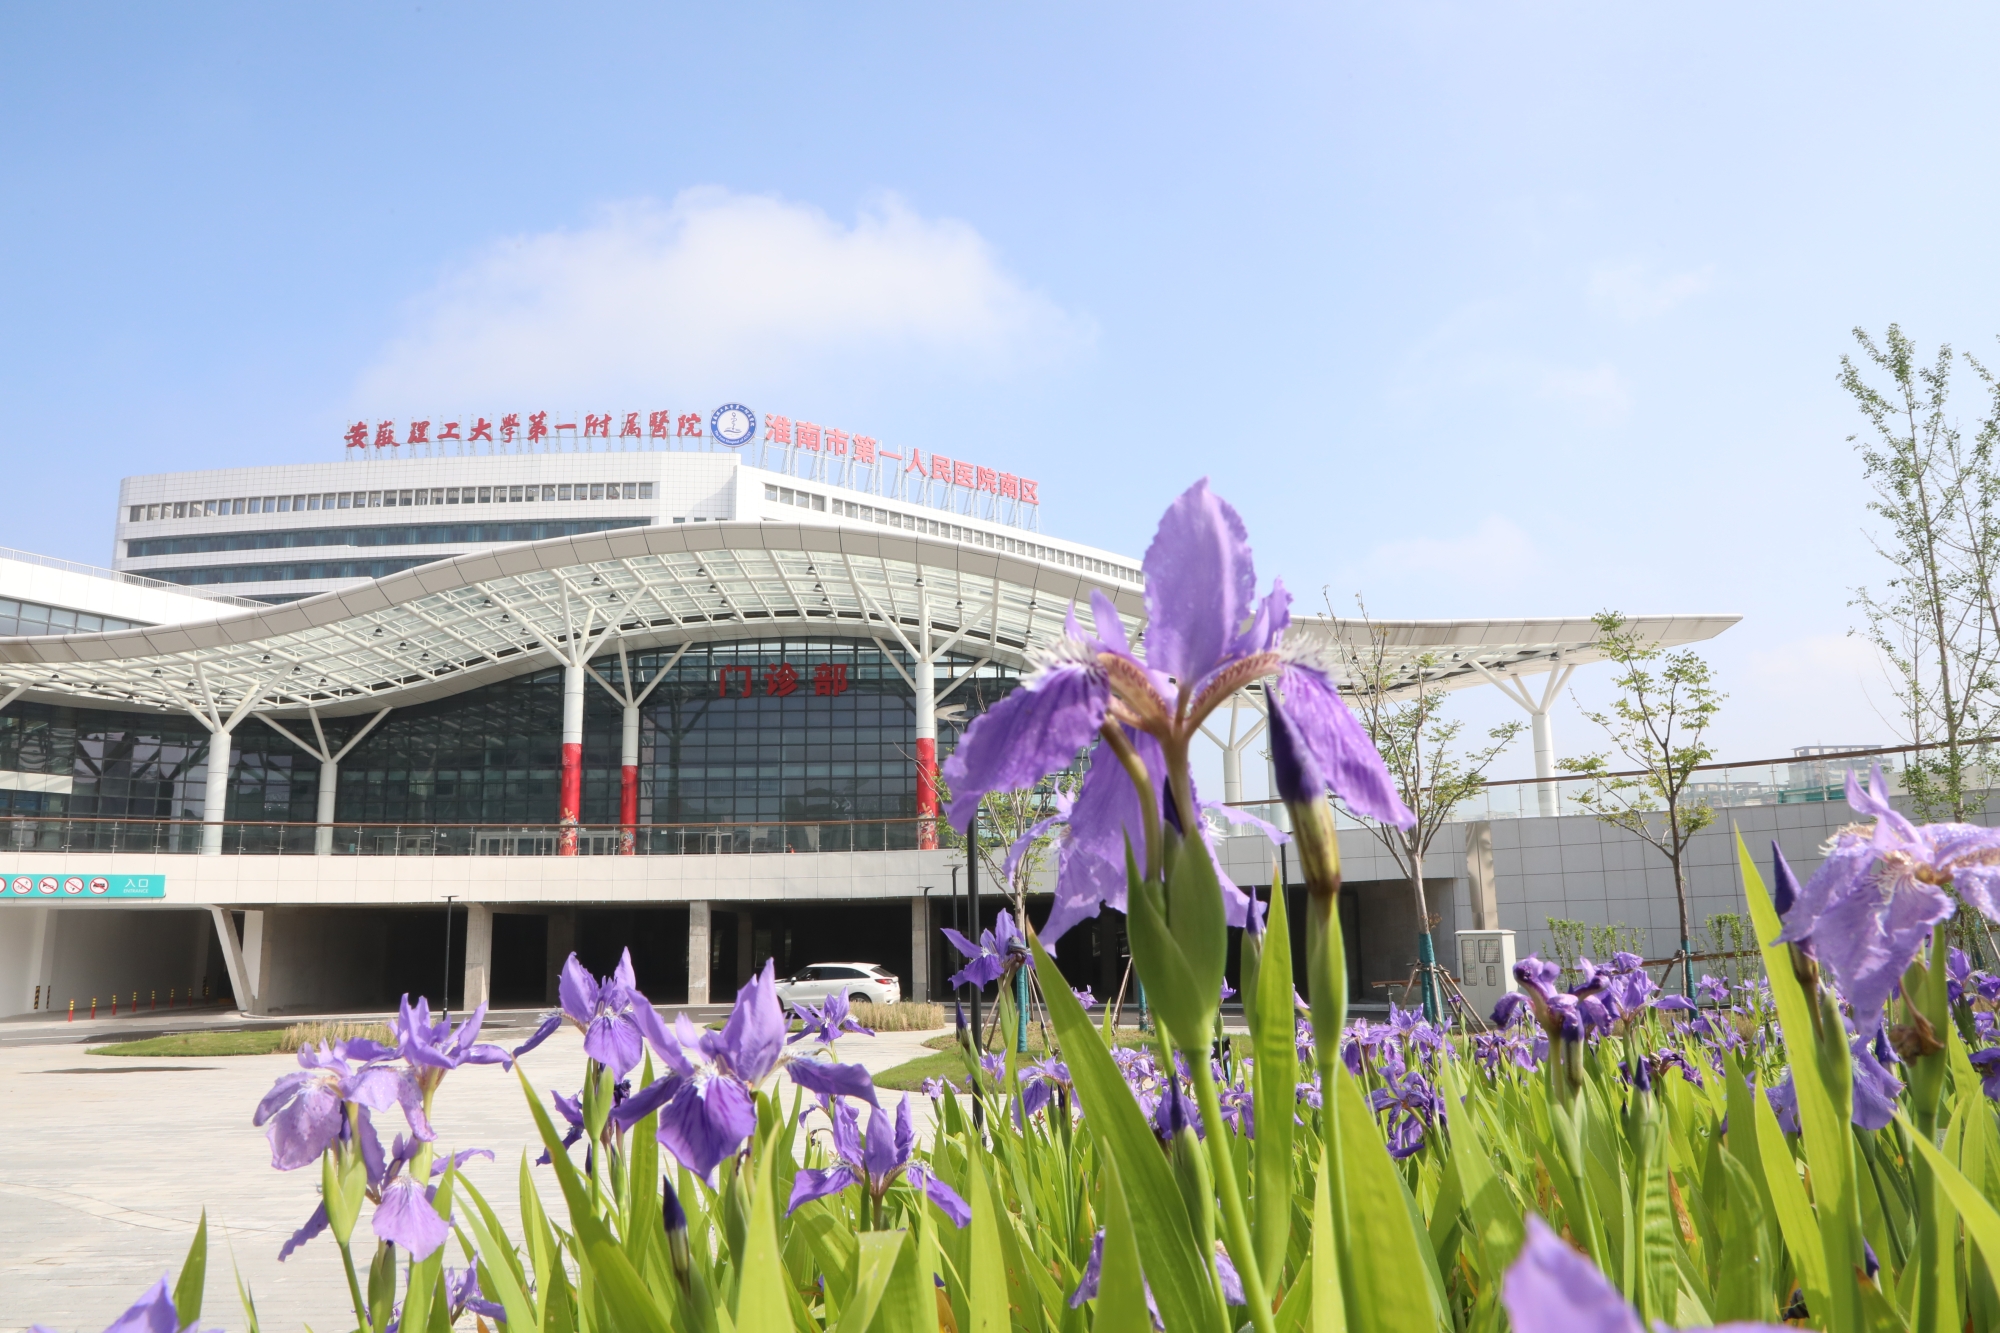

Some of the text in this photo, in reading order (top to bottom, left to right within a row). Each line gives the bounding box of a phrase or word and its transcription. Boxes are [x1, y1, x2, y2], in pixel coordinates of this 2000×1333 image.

[764, 413, 1040, 505] 淮南市第一人民医院南区
[719, 662, 848, 698] 门诊部
[124, 878, 149, 888] 入口
